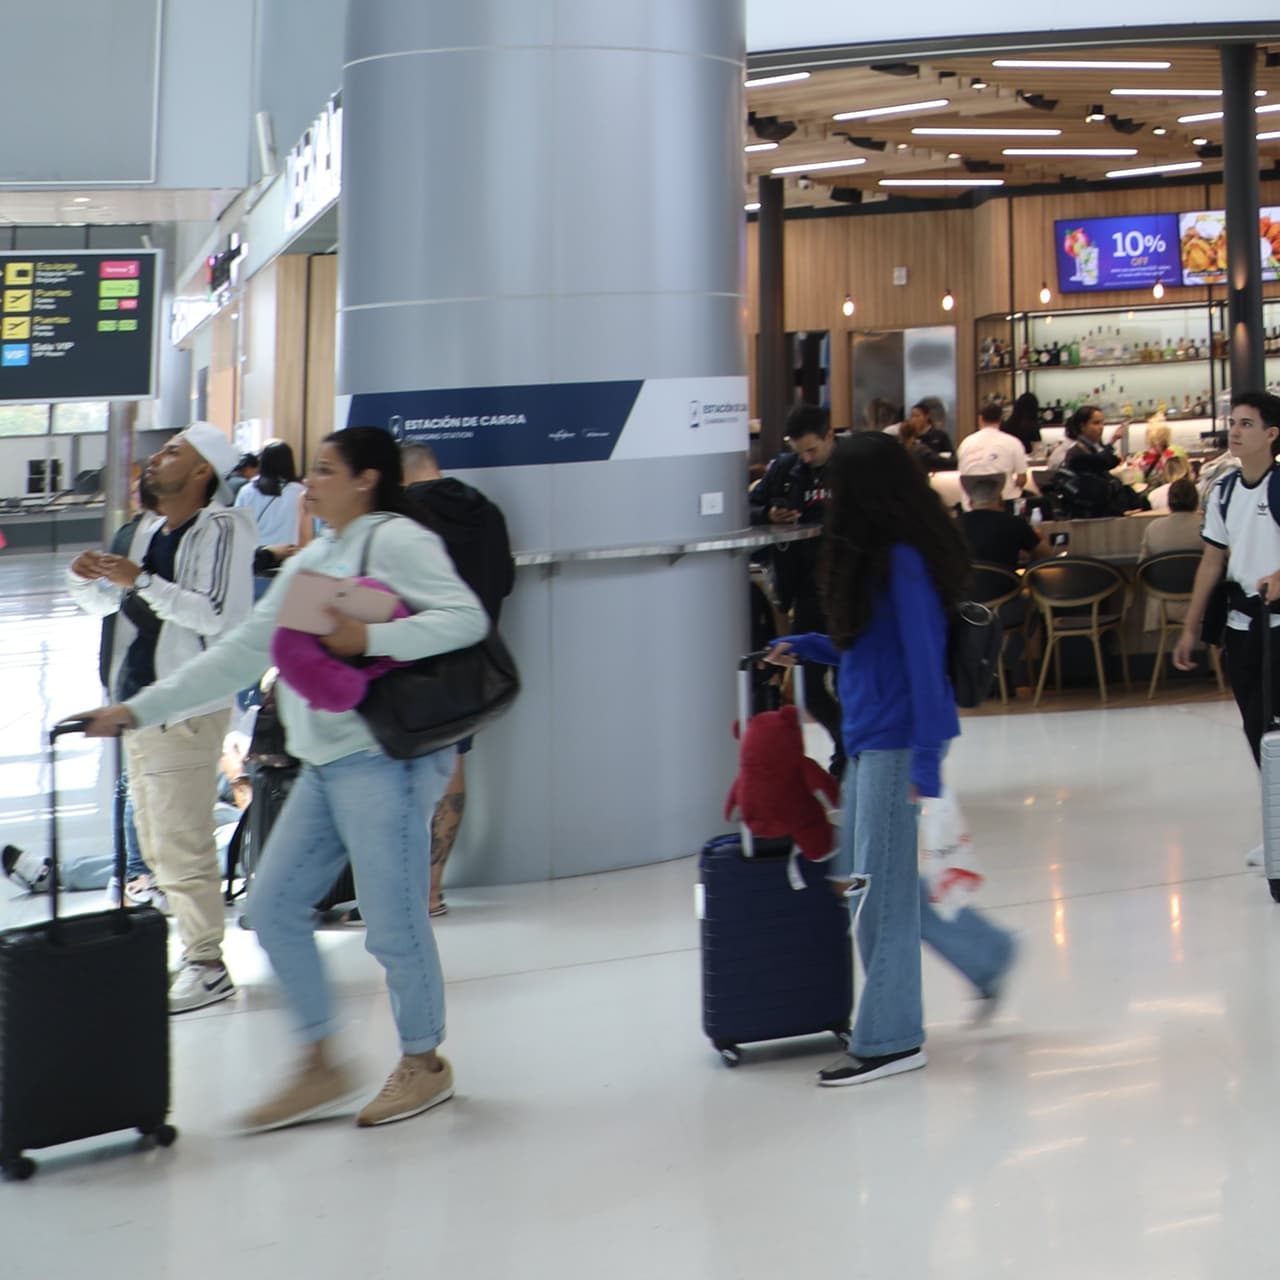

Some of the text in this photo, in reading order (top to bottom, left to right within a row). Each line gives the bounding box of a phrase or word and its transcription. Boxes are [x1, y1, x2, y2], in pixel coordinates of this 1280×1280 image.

[1112, 230, 1167, 257] 10%
[6, 351, 25, 359] VIP
[405, 414, 527, 431] ESTACIÓN DE CARGA
